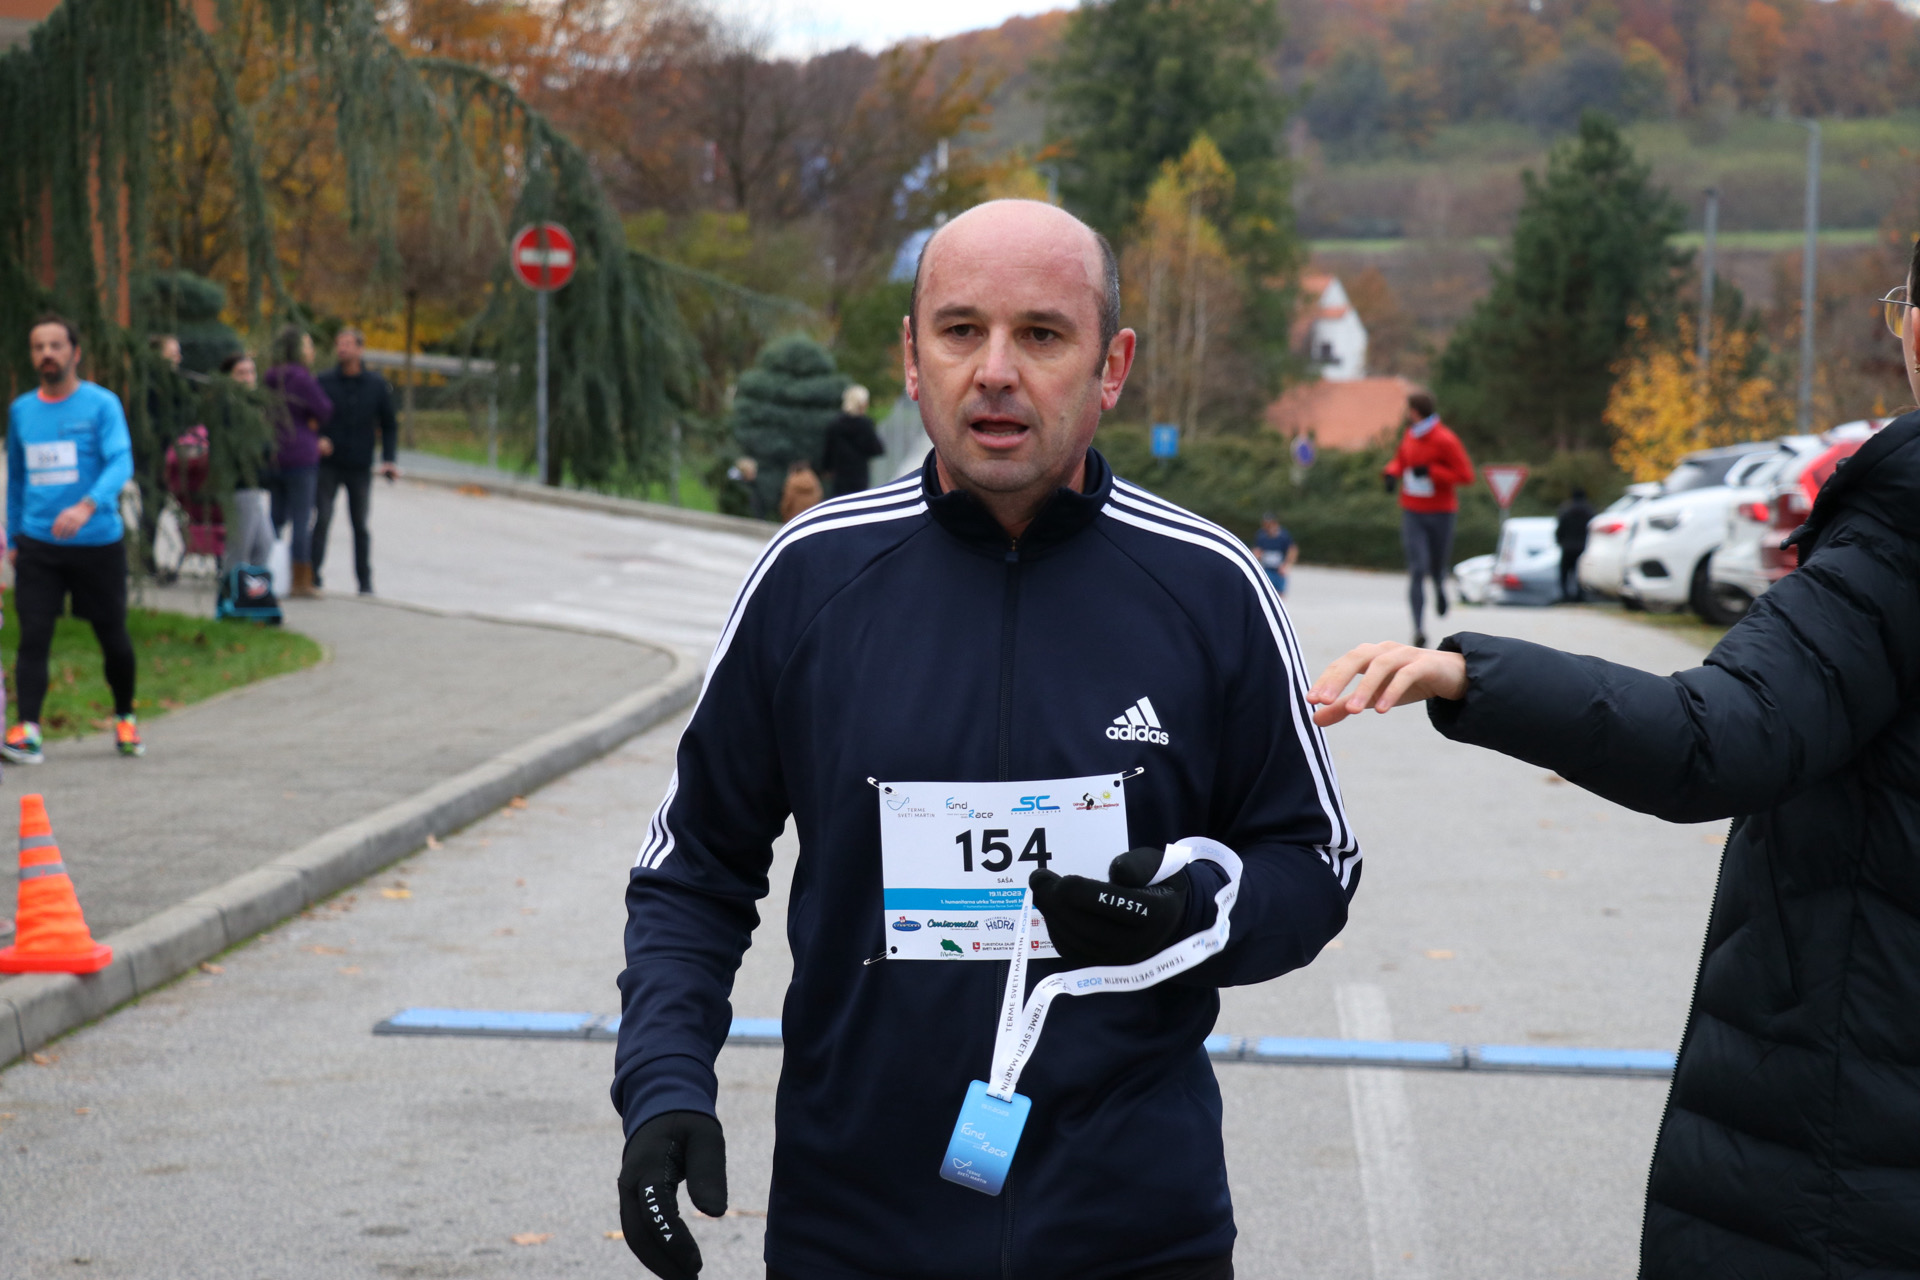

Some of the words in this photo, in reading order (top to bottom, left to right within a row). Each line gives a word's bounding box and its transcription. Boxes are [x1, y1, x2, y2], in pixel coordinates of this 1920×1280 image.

[1105, 724, 1169, 745] adidas
[945, 797, 968, 810] Fund
[955, 828, 1052, 872] 154
[1098, 892, 1148, 916] KIPSTA
[1015, 937, 1024, 974] MARTIN
[1156, 955, 1184, 974] TERME
[1010, 974, 1019, 999] SVETI
[1077, 977, 1102, 988] 2023
[1130, 970, 1155, 983] SVETI
[1006, 1001, 1016, 1032] TERME
[1027, 1003, 1044, 1032] TERME
[1016, 1033, 1032, 1057] SVETI
[1000, 1057, 1019, 1091] MARTIN
[960, 1122, 986, 1140] Fund
[969, 1175, 987, 1184] MARTIN
[644, 1185, 673, 1242] KIPSTA
